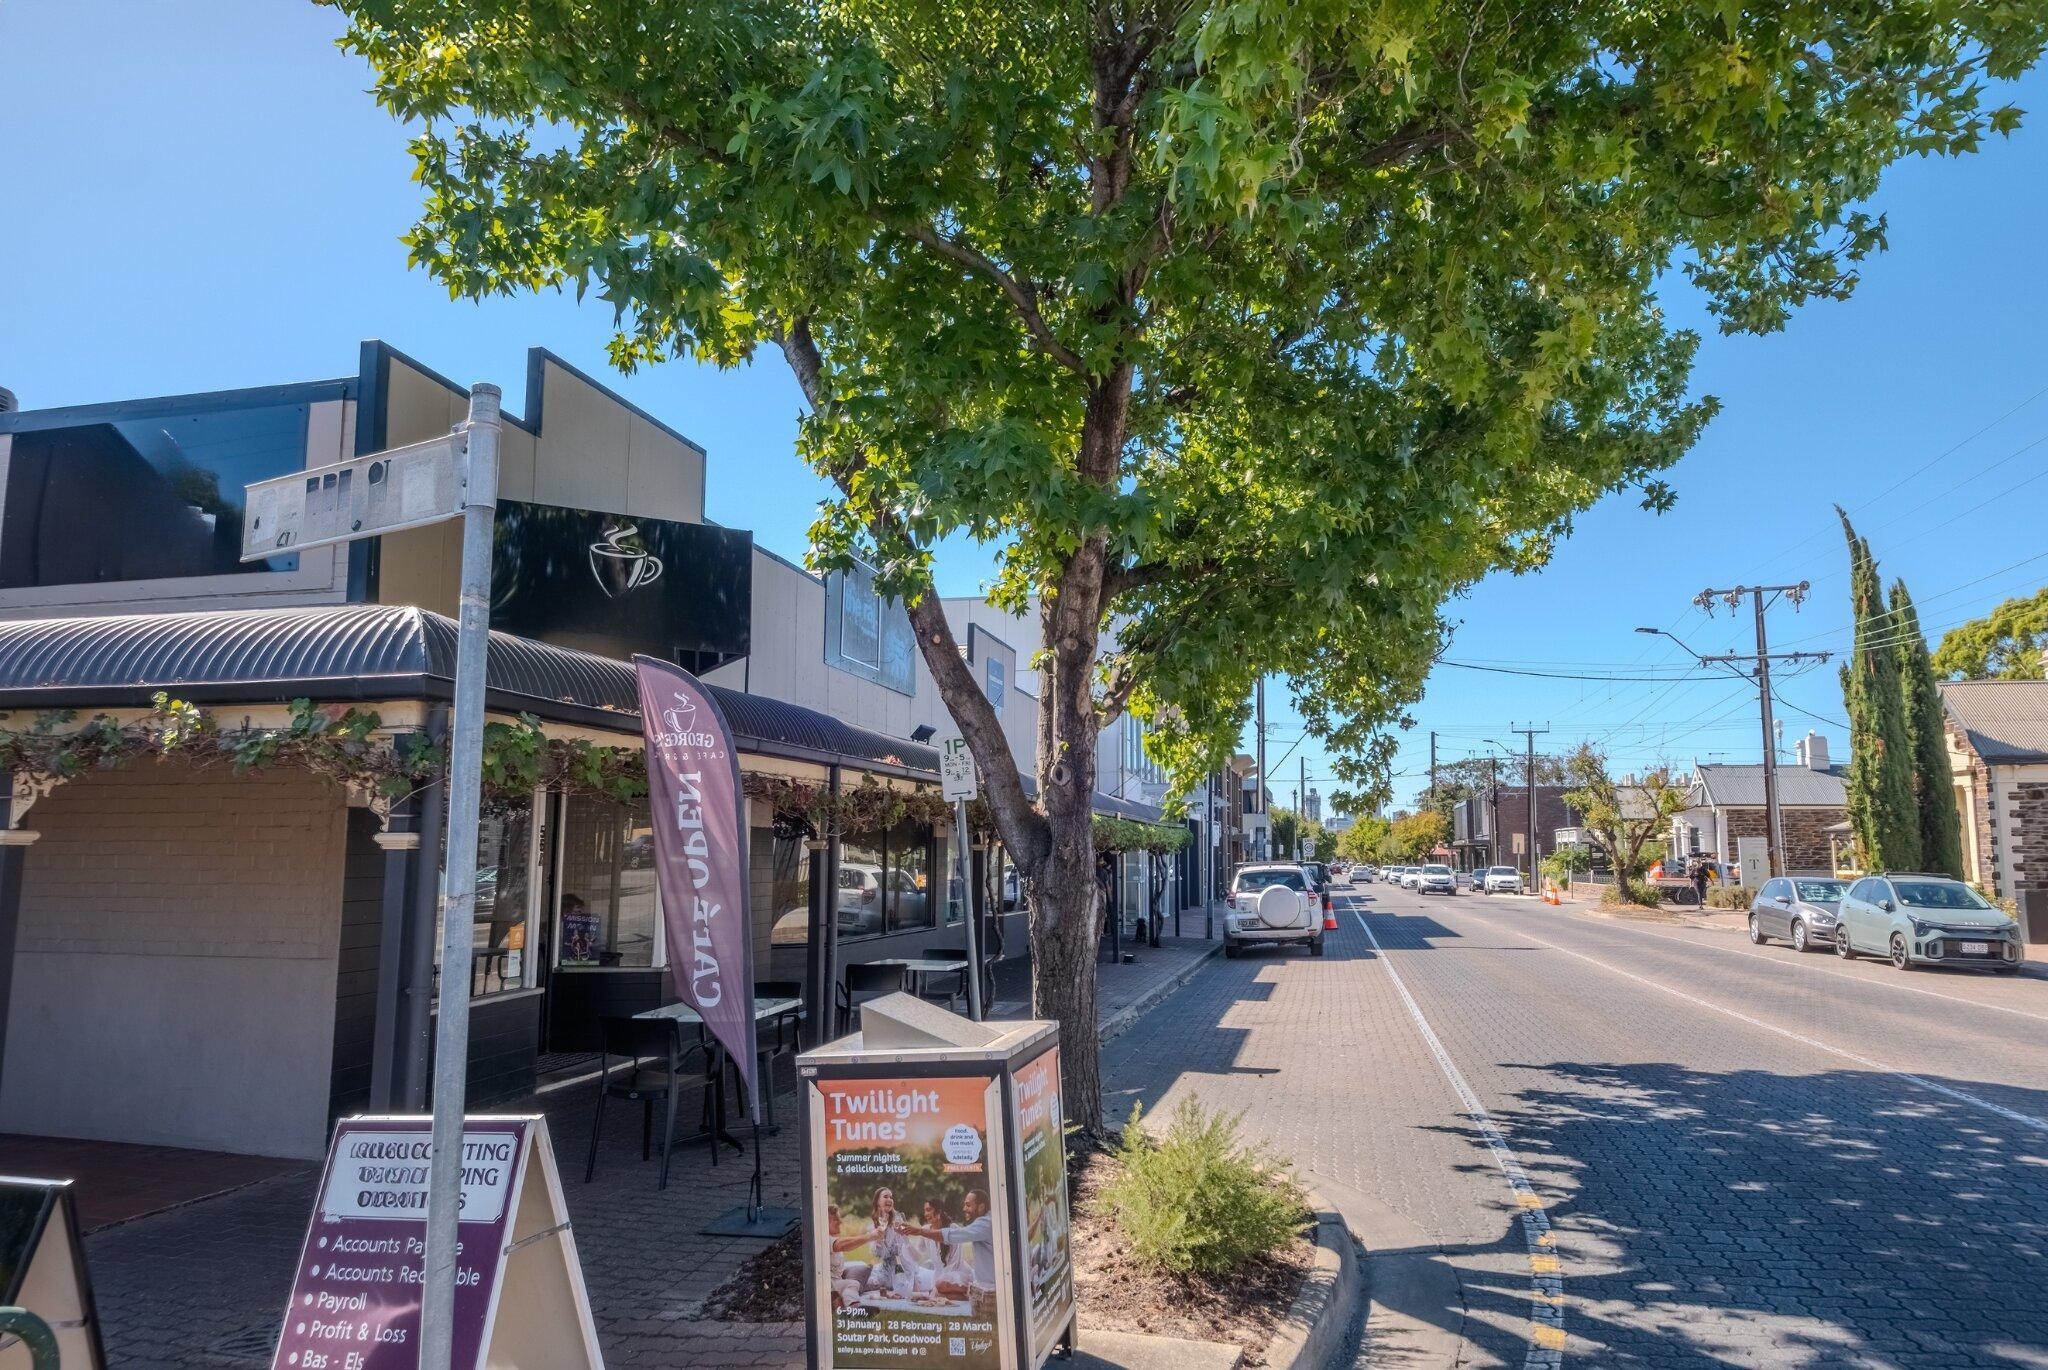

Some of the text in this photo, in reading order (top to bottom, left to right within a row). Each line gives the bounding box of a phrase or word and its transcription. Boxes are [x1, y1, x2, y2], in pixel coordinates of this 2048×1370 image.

[945, 739, 967, 754] 1P
[829, 1089, 940, 1119] Twilight
[830, 1118, 907, 1141] Tunes
[836, 1153, 901, 1164] Summer nights
[837, 1164, 908, 1174] & delicious bites
[332, 1235, 401, 1255] Accounts
[323, 1263, 394, 1284] Accounts
[317, 1291, 368, 1314] Payroll
[309, 1320, 408, 1344] Profit & Loss
[836, 1319, 993, 1333] 31 January 28 February 28 March
[837, 1332, 942, 1345] Soutar Park, Goodwood
[302, 1349, 329, 1369] Bas
